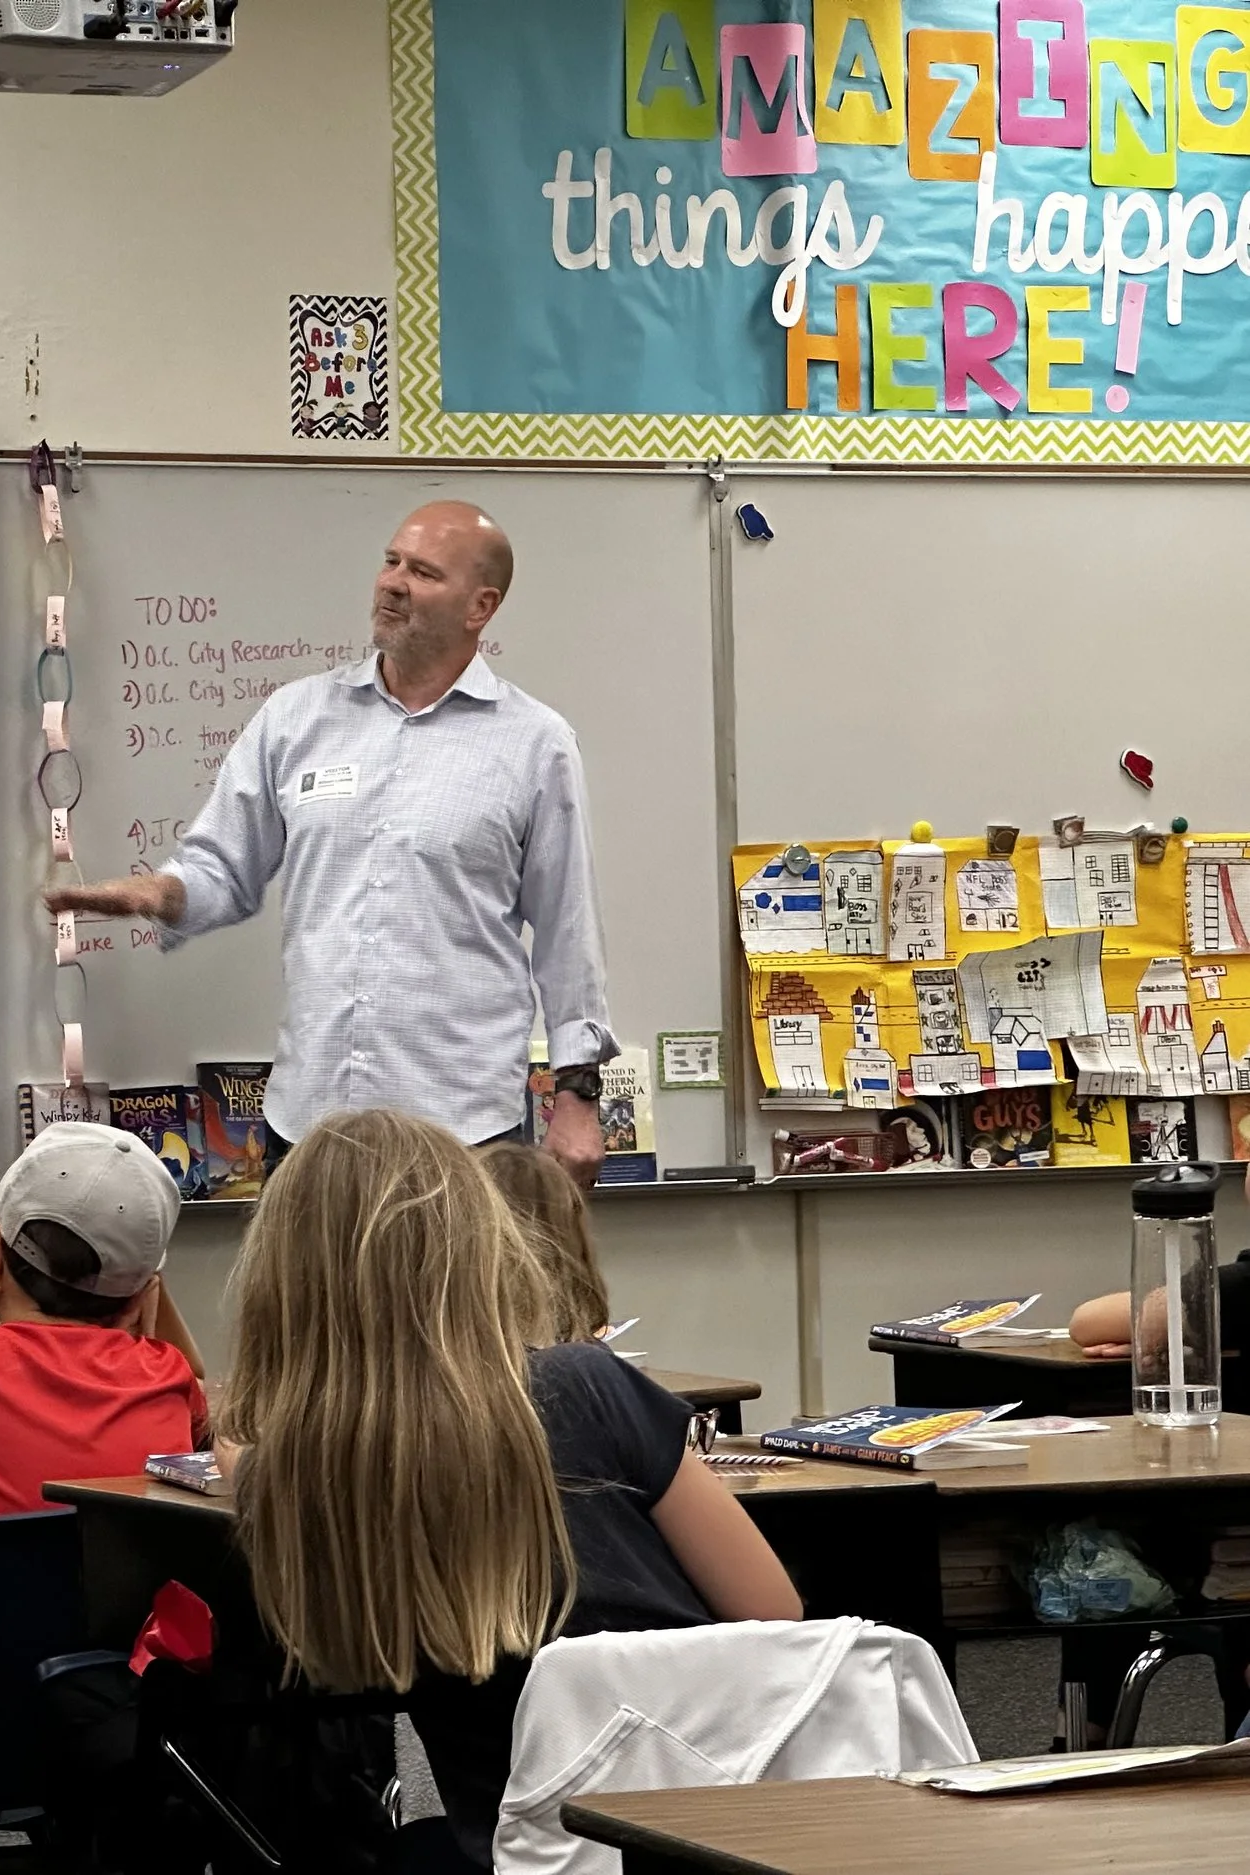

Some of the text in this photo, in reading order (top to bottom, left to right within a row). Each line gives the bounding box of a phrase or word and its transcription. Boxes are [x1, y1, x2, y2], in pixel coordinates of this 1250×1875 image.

[637, 12, 1250, 156] AMAZING
[542, 147, 885, 328] things
[311, 323, 369, 351] Ask 3
[786, 281, 1149, 414] HERE!
[304, 352, 377, 373] Before
[324, 375, 355, 398] Me
[135, 597, 172, 626] TO
[189, 641, 225, 674] City
[190, 680, 224, 708] City
[234, 677, 285, 700] Slide
[214, 1073, 268, 1098] WINGS
[111, 1094, 177, 1112] DRAGON
[973, 1103, 1042, 1131] GUYS
[120, 1108, 173, 1127] GIRLS
[764, 1437, 783, 1447] ROALD
[784, 1440, 800, 1450] DAHL
[822, 1443, 841, 1455] JAMES
[857, 1448, 877, 1459] GIANT
[878, 1451, 898, 1463] PEACH
